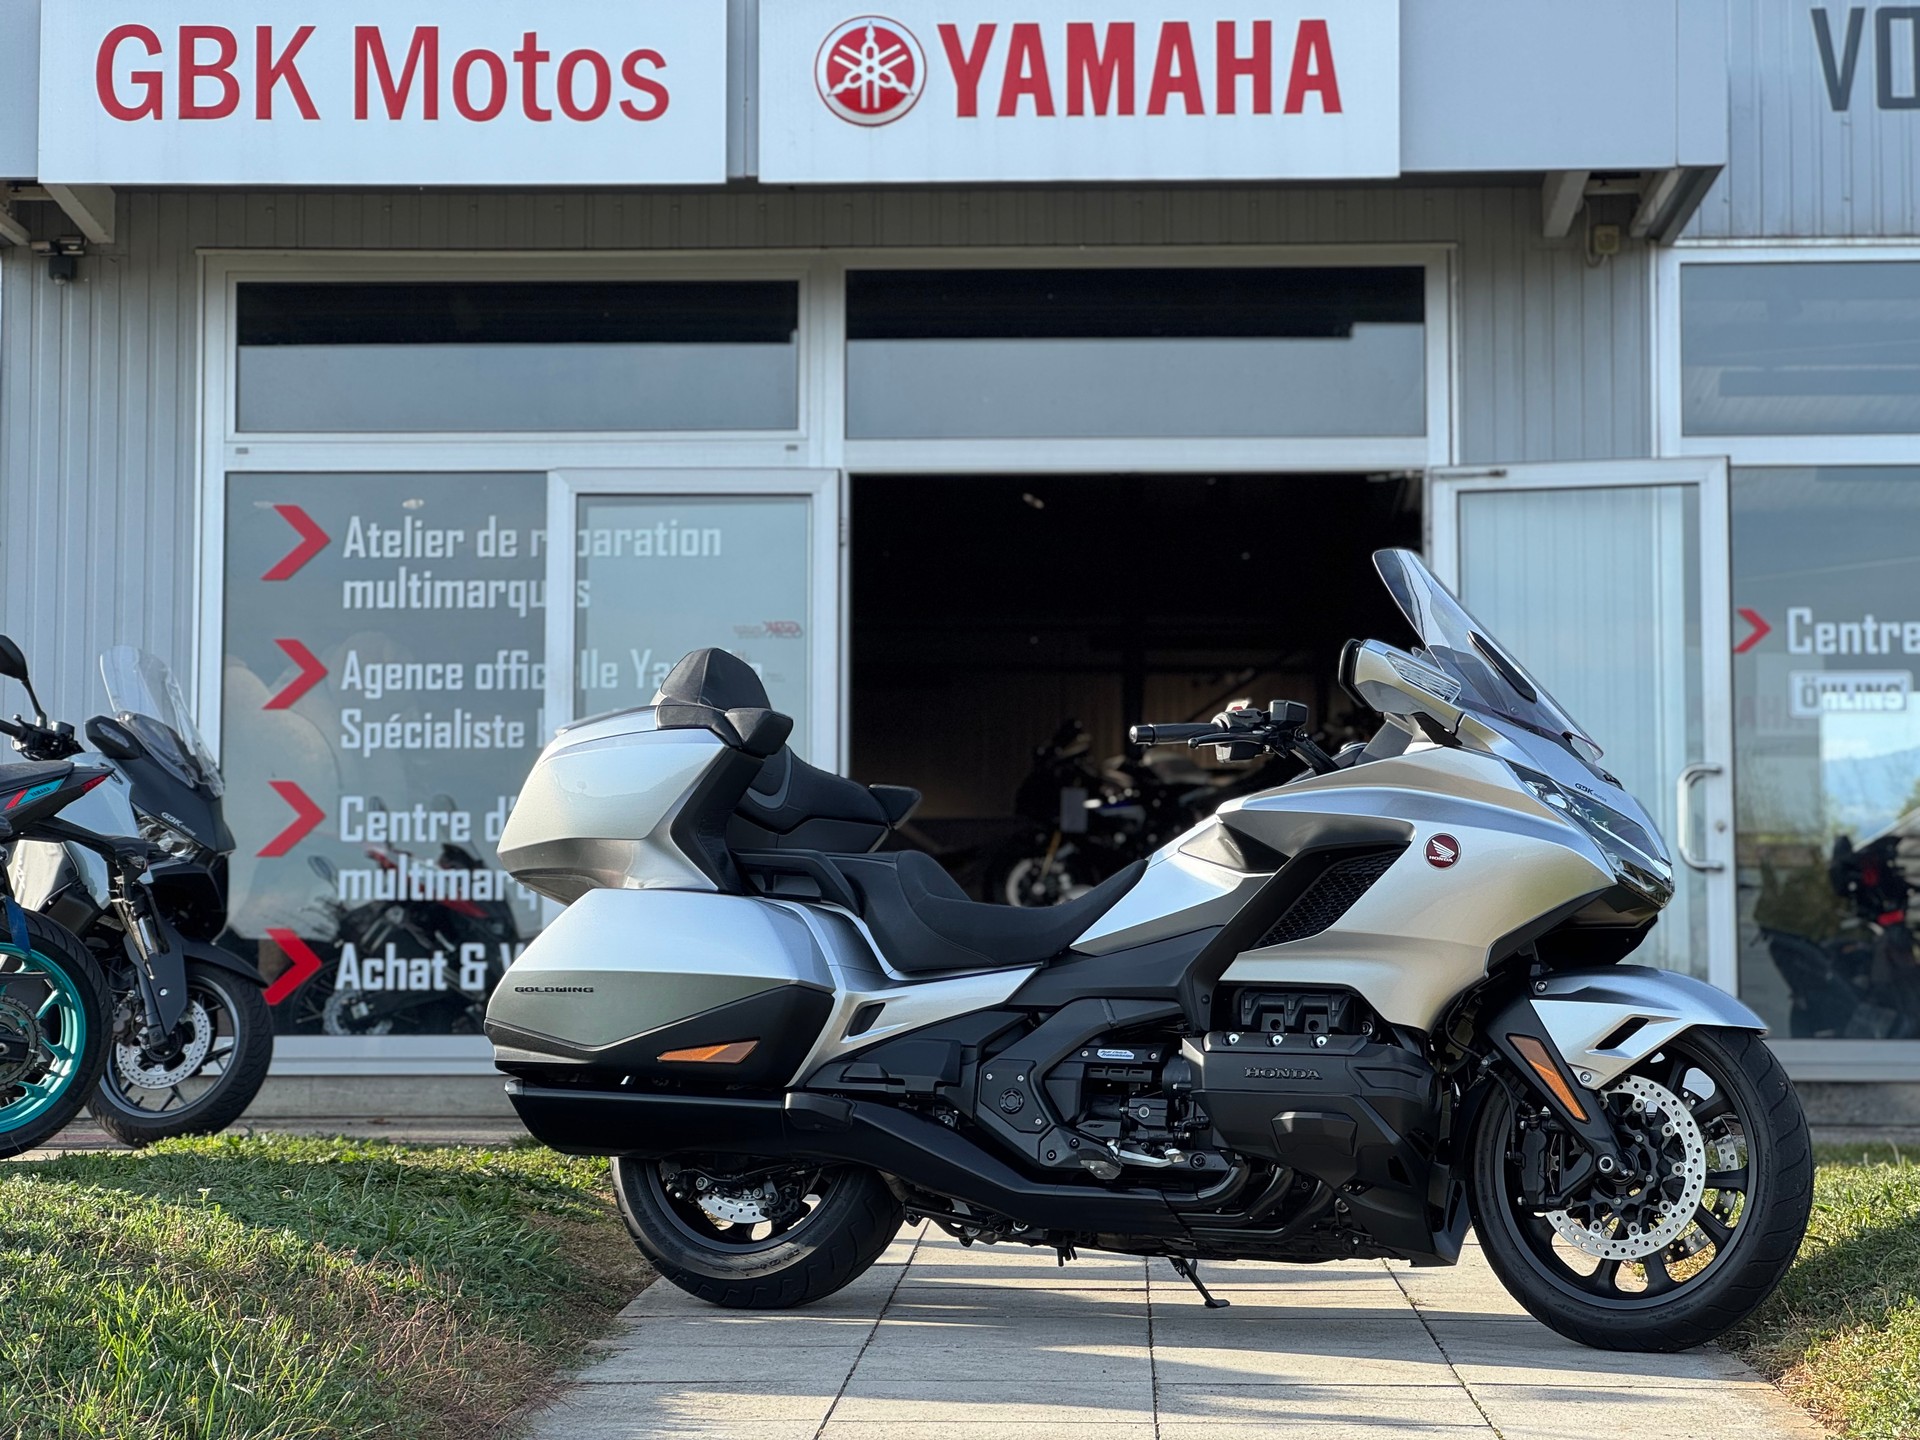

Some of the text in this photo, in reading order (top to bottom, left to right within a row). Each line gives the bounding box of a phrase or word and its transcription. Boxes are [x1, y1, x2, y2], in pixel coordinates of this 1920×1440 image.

[96, 23, 670, 123] GBK Motos
[936, 18, 1344, 118] YAMAHA
[1810, 6, 1920, 112] VO
[342, 514, 722, 559] Atelier de raration
[342, 565, 591, 618] multimarqus
[1786, 606, 1920, 655] Centre
[340, 649, 464, 700] Agence
[475, 648, 619, 690] officlle
[340, 707, 525, 758] Spécialiste
[339, 795, 471, 843] Centre
[334, 942, 448, 991] Achat
[459, 942, 488, 991] &
[1243, 1066, 1323, 1080] HONDA
